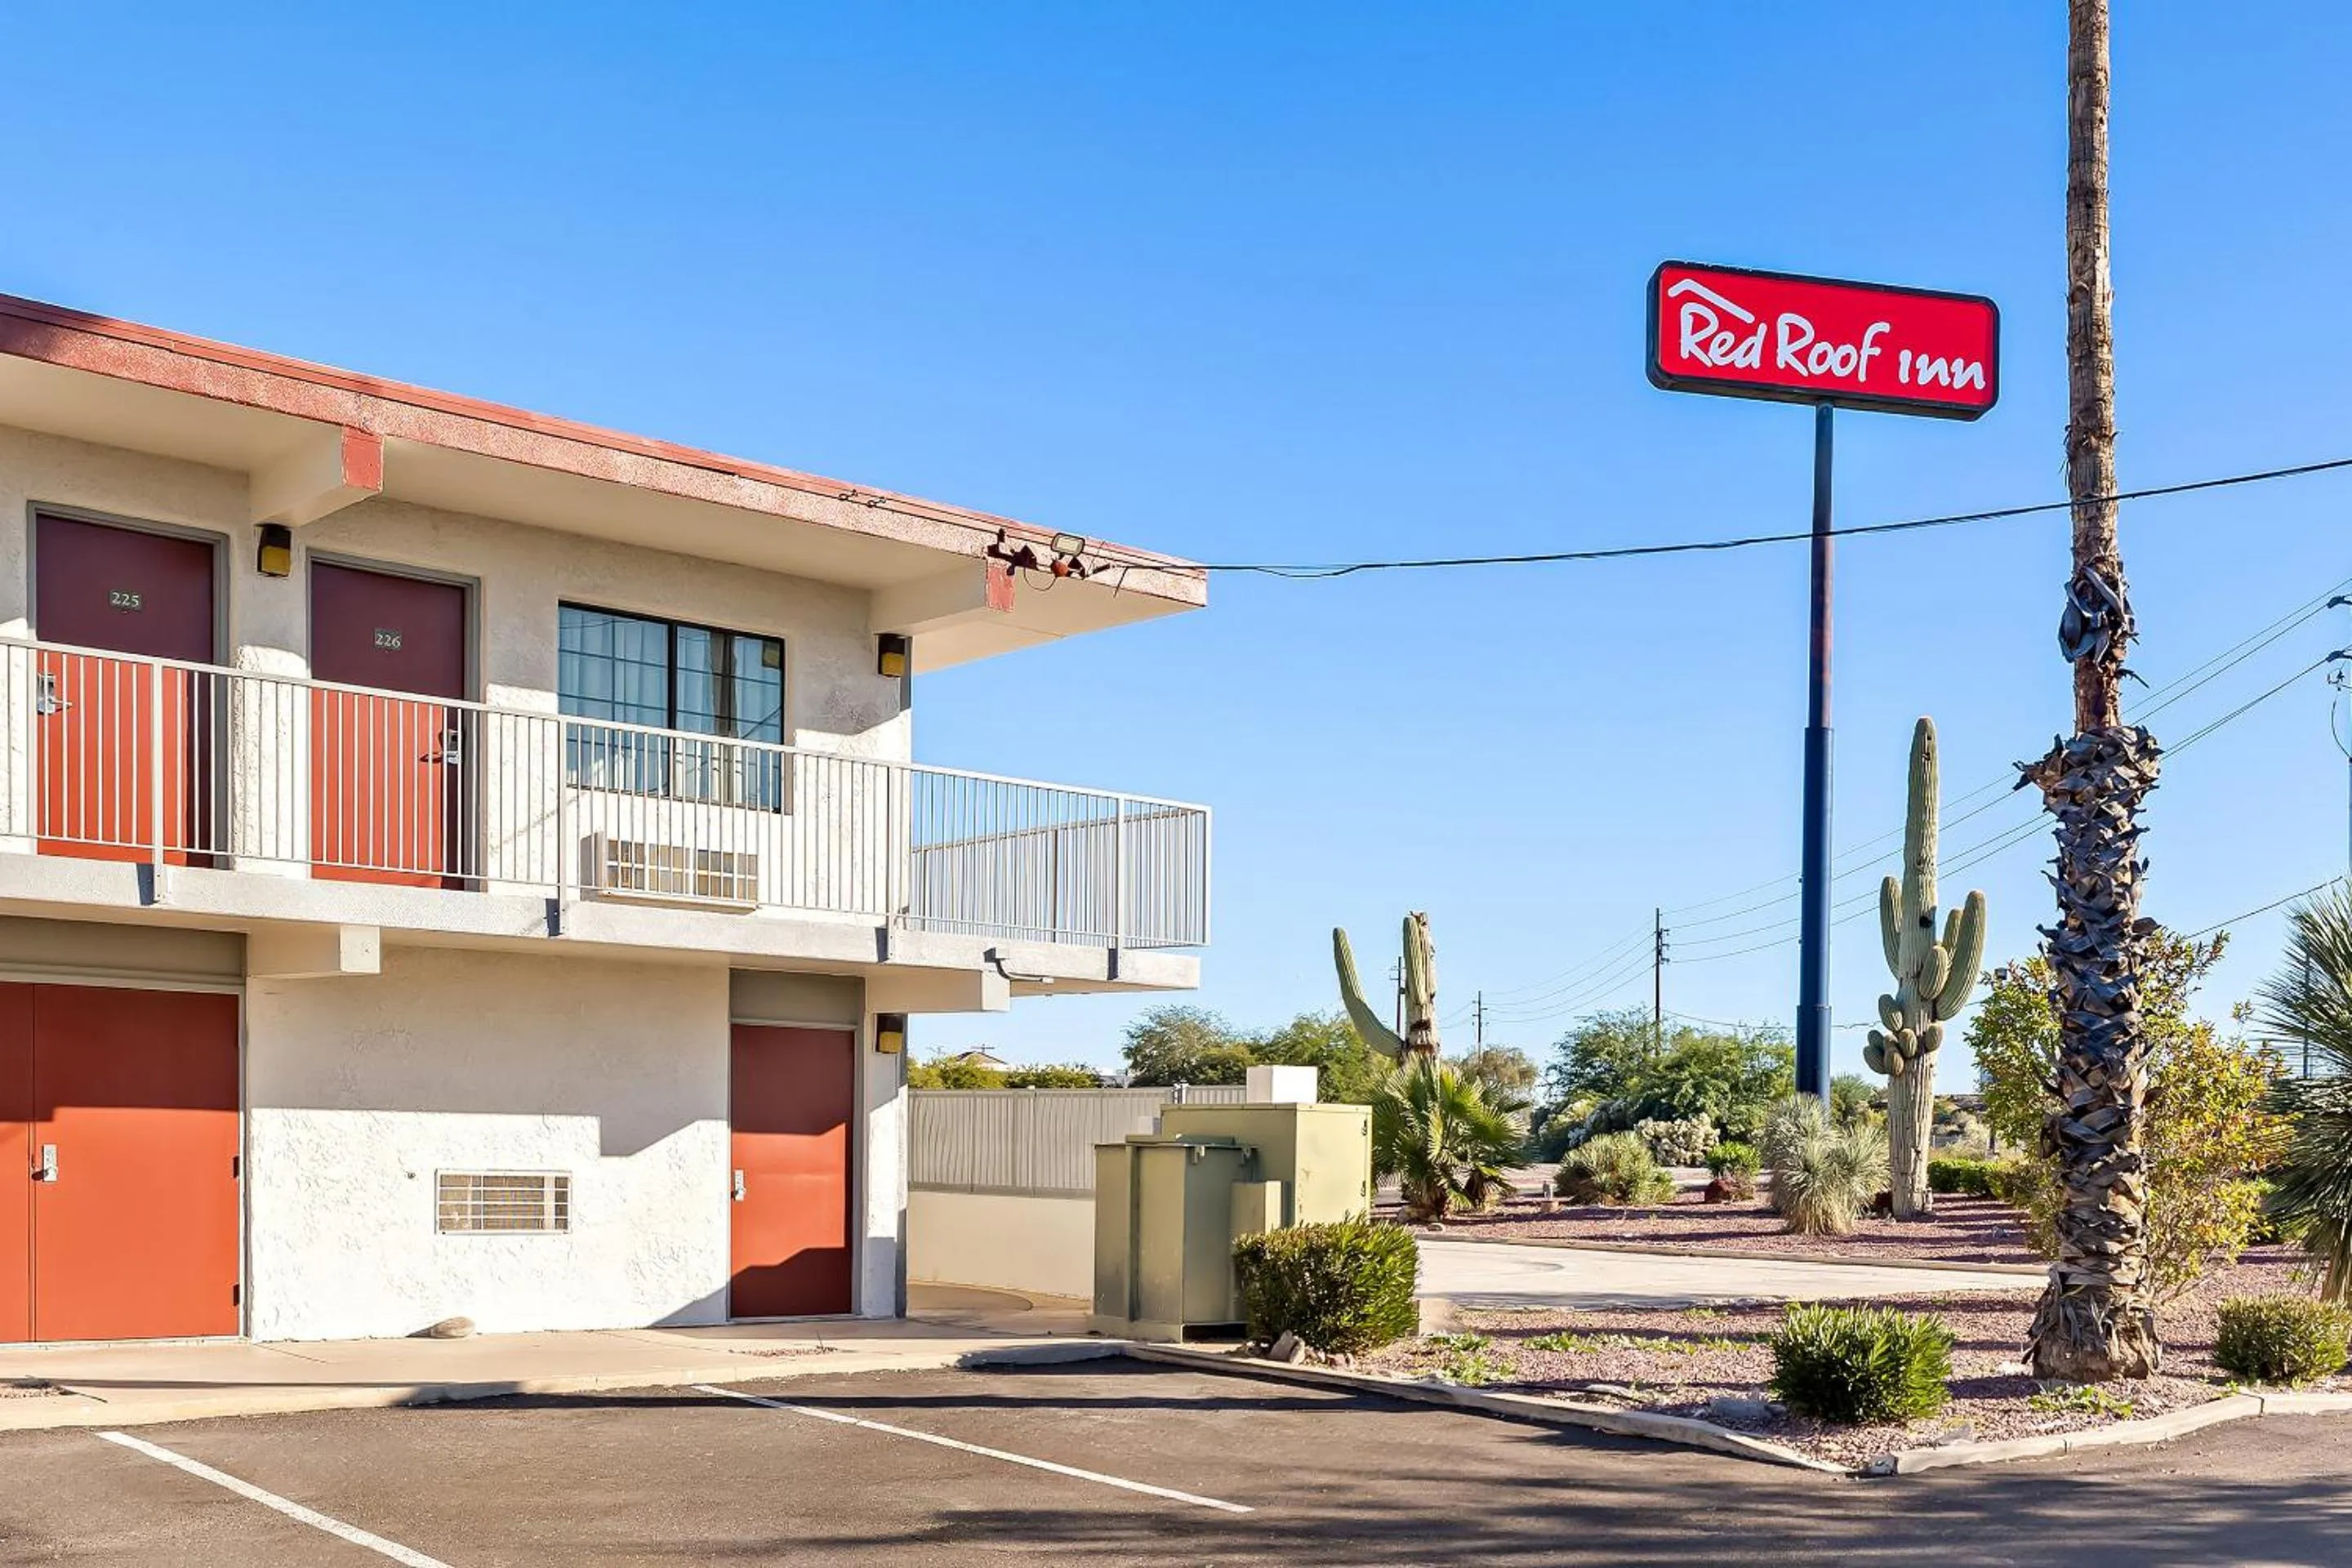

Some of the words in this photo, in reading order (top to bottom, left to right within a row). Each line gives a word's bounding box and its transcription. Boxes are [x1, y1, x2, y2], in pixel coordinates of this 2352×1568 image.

[1680, 302, 1766, 368] Red
[1775, 313, 1890, 381] Roof
[111, 591, 140, 608] 225
[376, 633, 401, 648] 226
